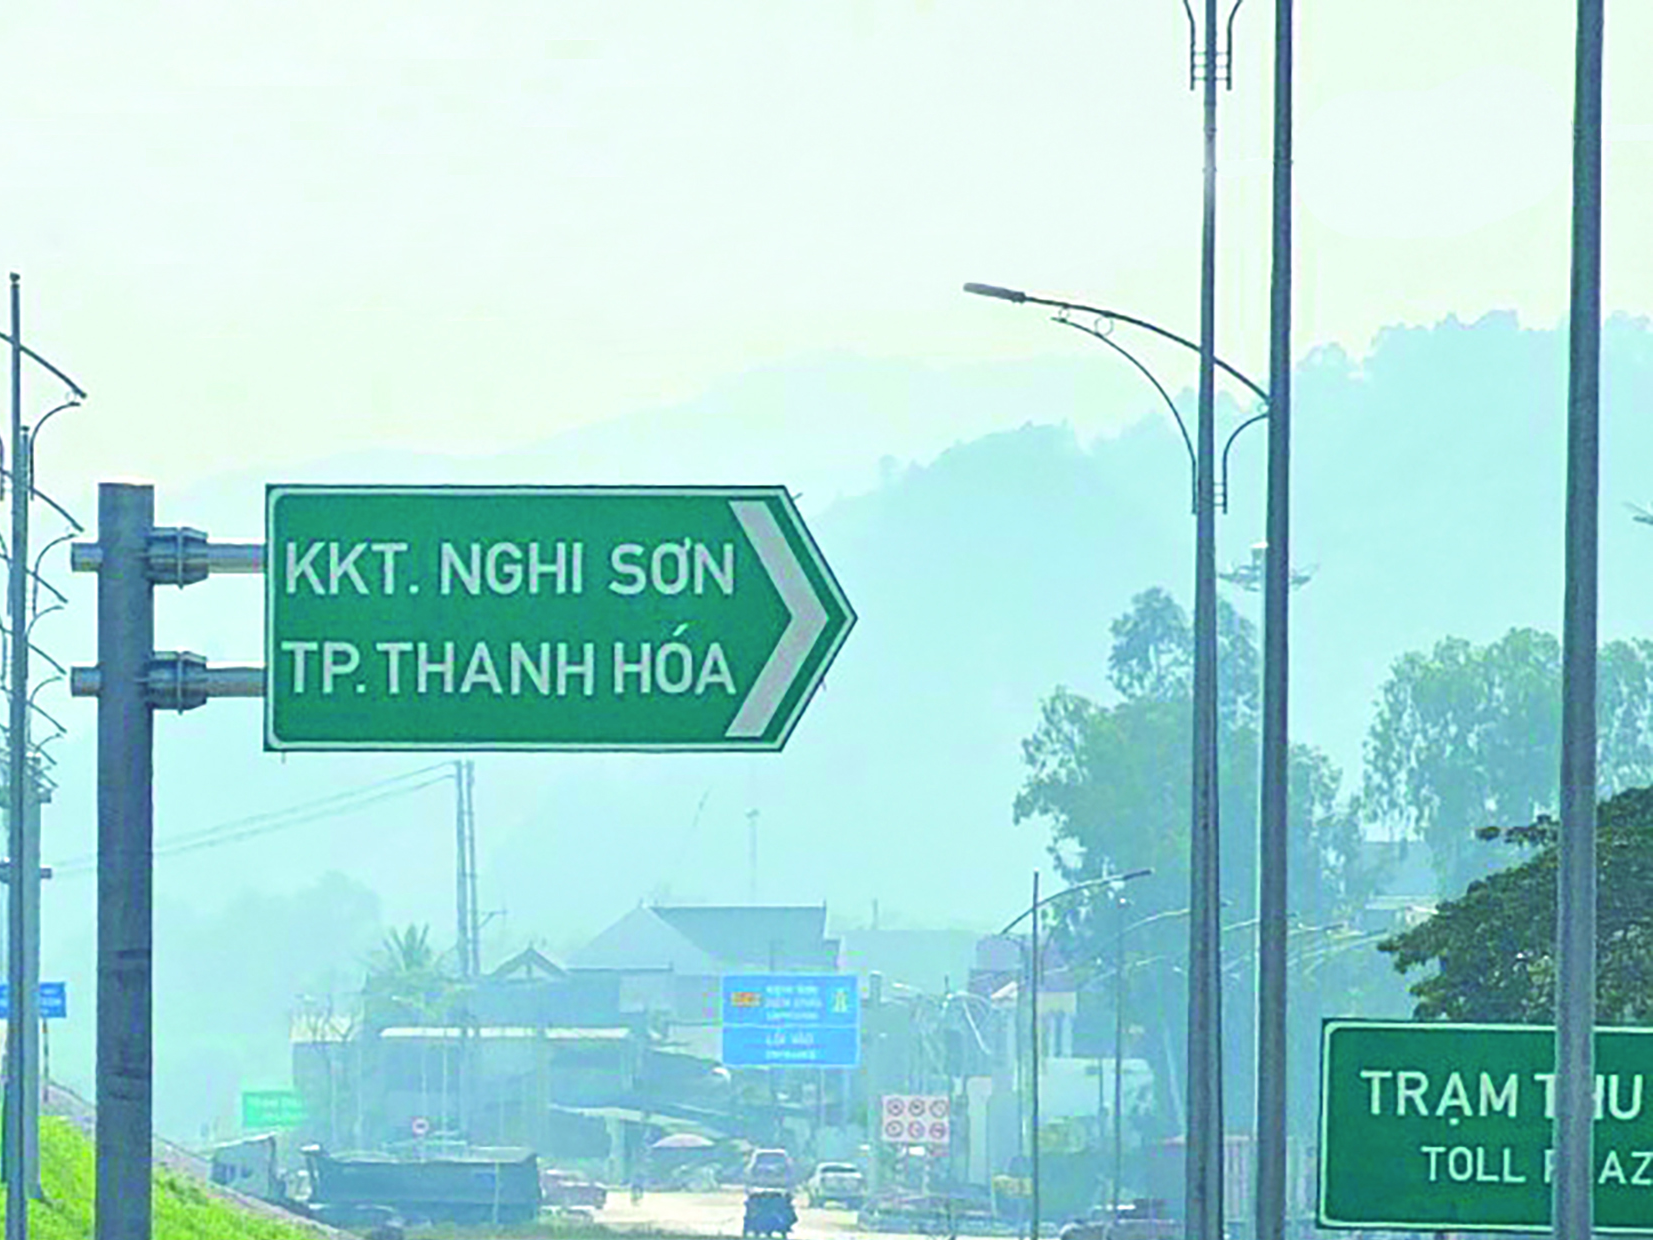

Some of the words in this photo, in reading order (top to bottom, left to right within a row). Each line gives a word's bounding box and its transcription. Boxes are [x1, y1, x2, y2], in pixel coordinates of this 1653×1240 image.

[284, 541, 419, 595] KKT.
[441, 541, 584, 595] NGHI
[609, 537, 736, 596] SƠN
[281, 641, 367, 695] TP.
[376, 641, 595, 696] THANH
[613, 623, 737, 696] HÓA
[1360, 1070, 1518, 1126] TRẠM
[1421, 1146, 1526, 1183] TOLL
